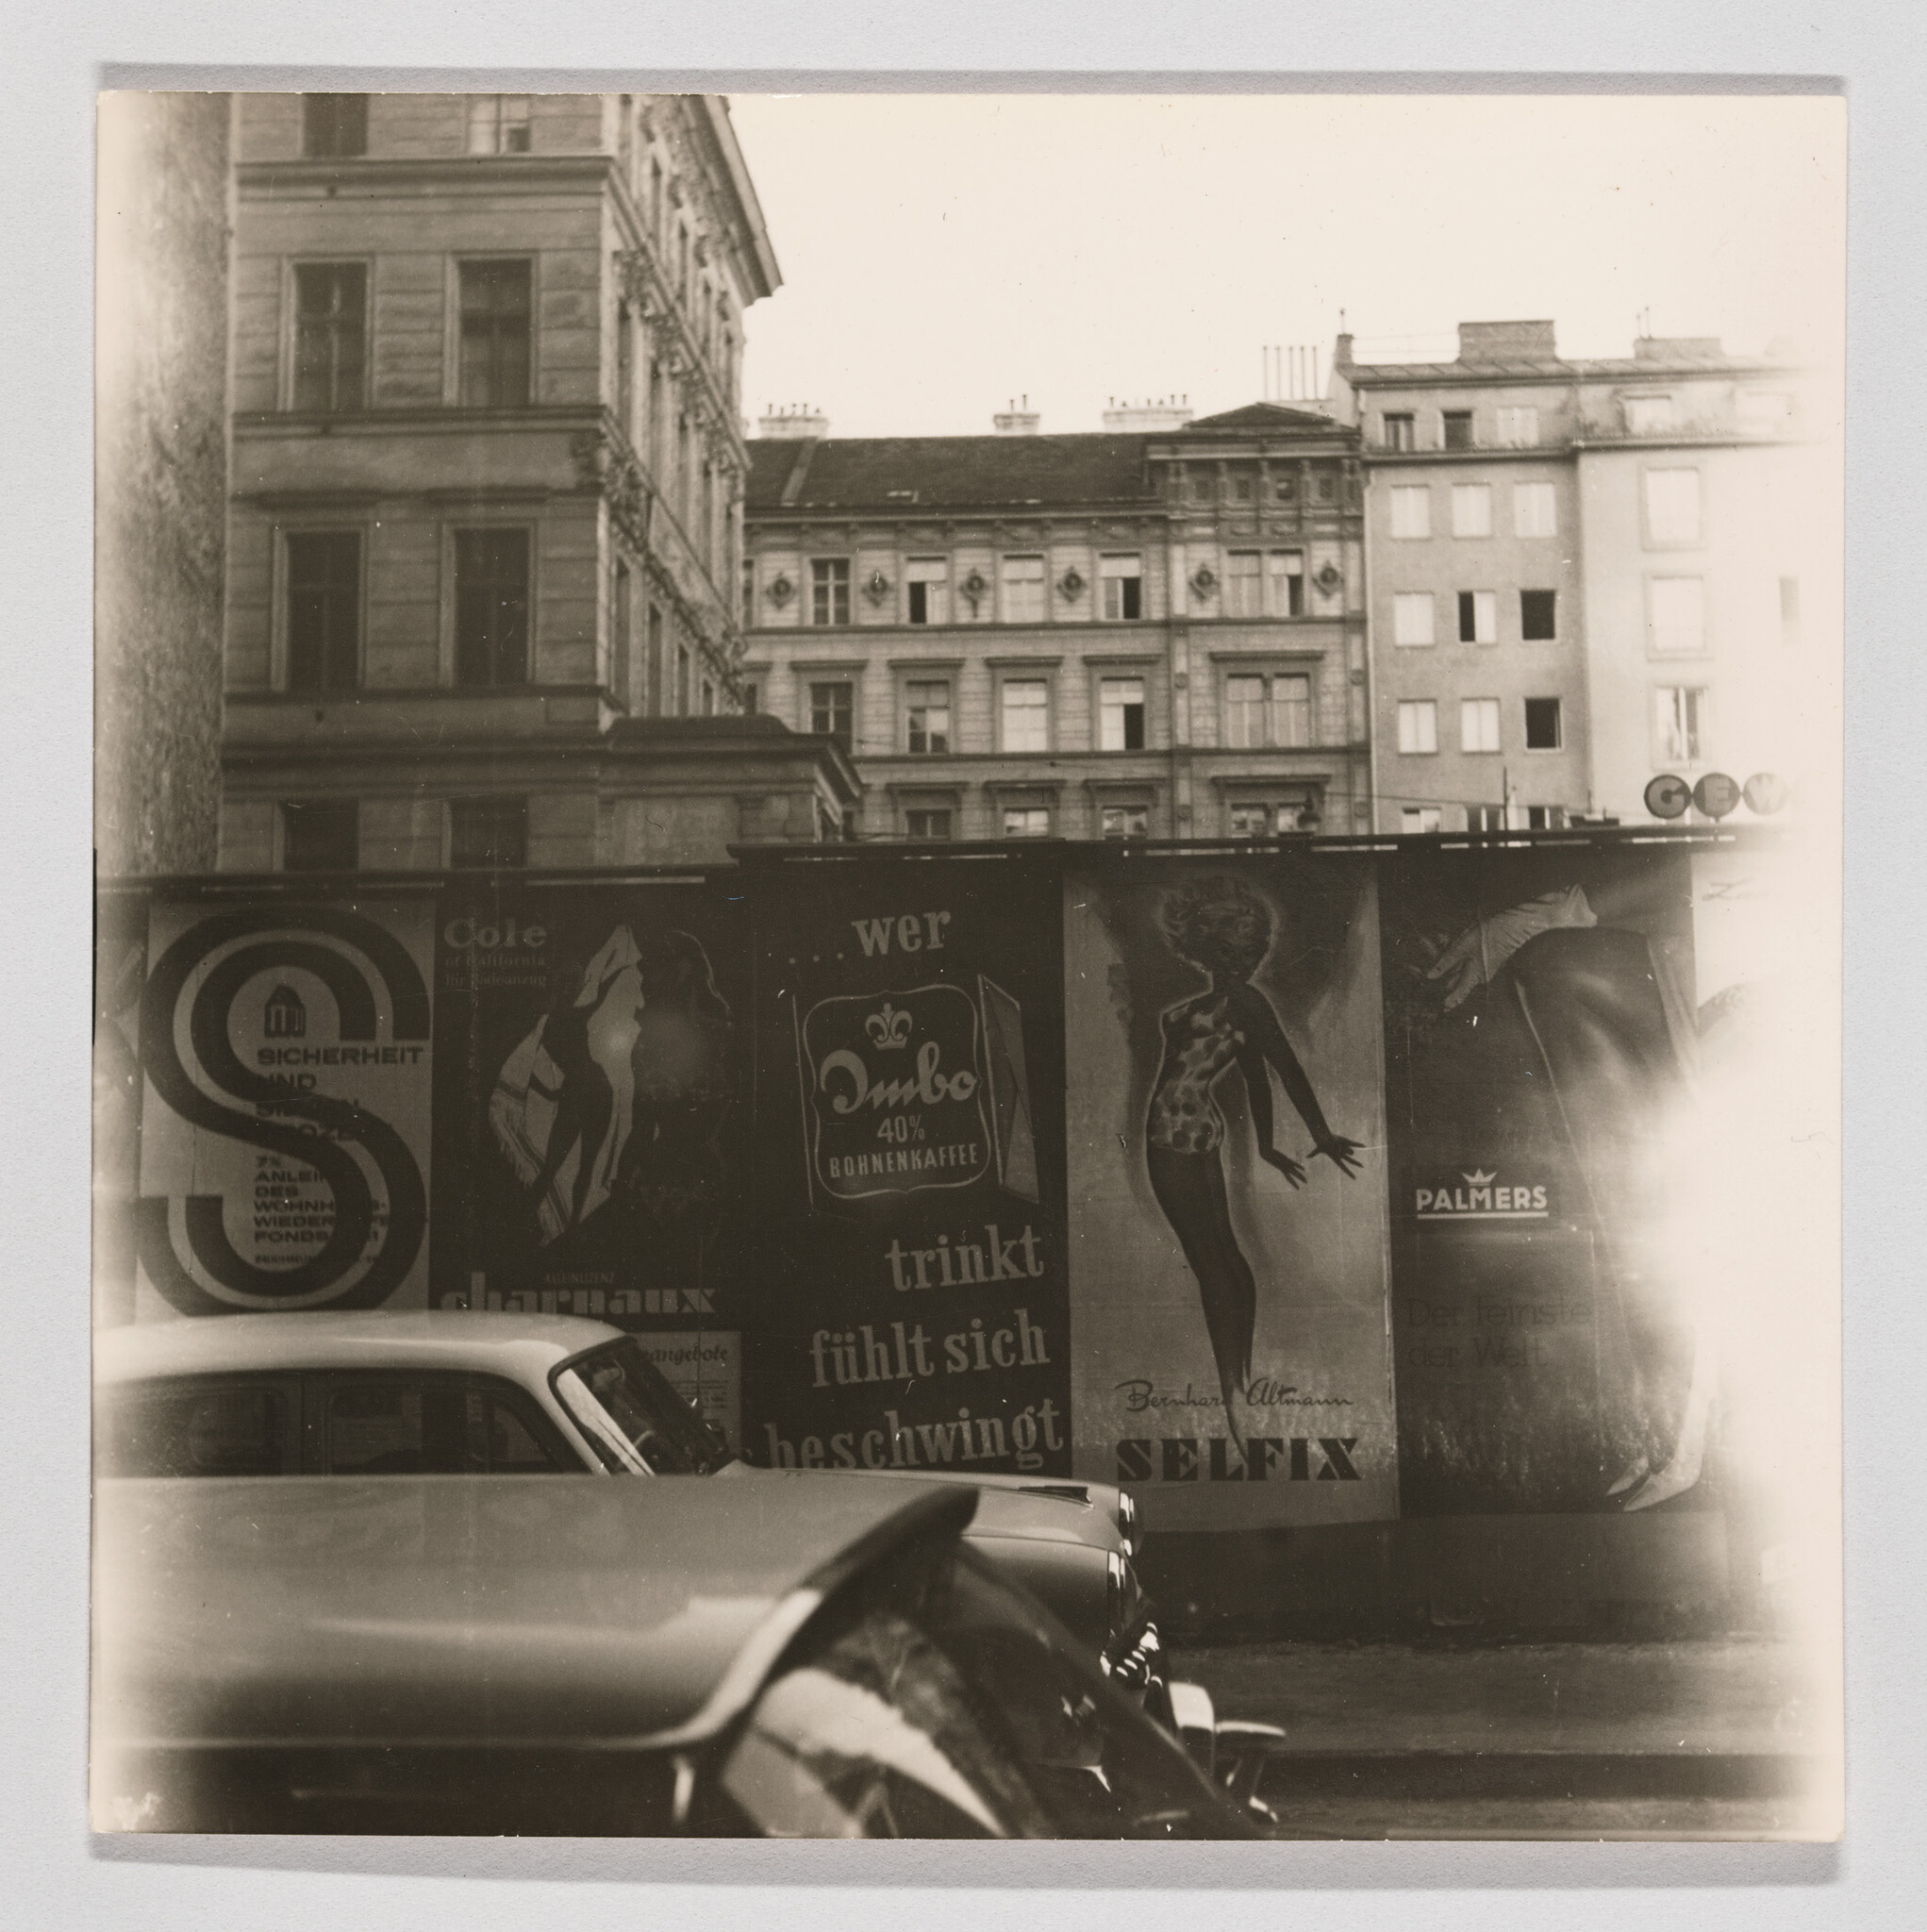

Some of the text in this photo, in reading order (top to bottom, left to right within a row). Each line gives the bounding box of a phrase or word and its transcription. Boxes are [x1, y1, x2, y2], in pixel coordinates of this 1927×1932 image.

[443, 917, 547, 948] Cole
[852, 909, 952, 958] wer
[257, 1046, 424, 1066] SICHERHEIT
[876, 1114, 925, 1144] 40%
[829, 1143, 978, 1179] BOHNENKAFFEE
[255, 1185, 299, 1198] DES
[1415, 1185, 1549, 1211] PALMERS
[884, 1224, 1046, 1292] trinkt
[439, 1270, 717, 1315] charnaux
[1406, 1297, 1465, 1327] Der
[809, 1307, 1052, 1389] fühlt sich
[1472, 1336, 1548, 1368] Welt
[1114, 1376, 1355, 1413] Bernhar Altmann
[763, 1398, 1064, 1471] beschwingt
[1115, 1438, 1362, 1482] SELFIX
